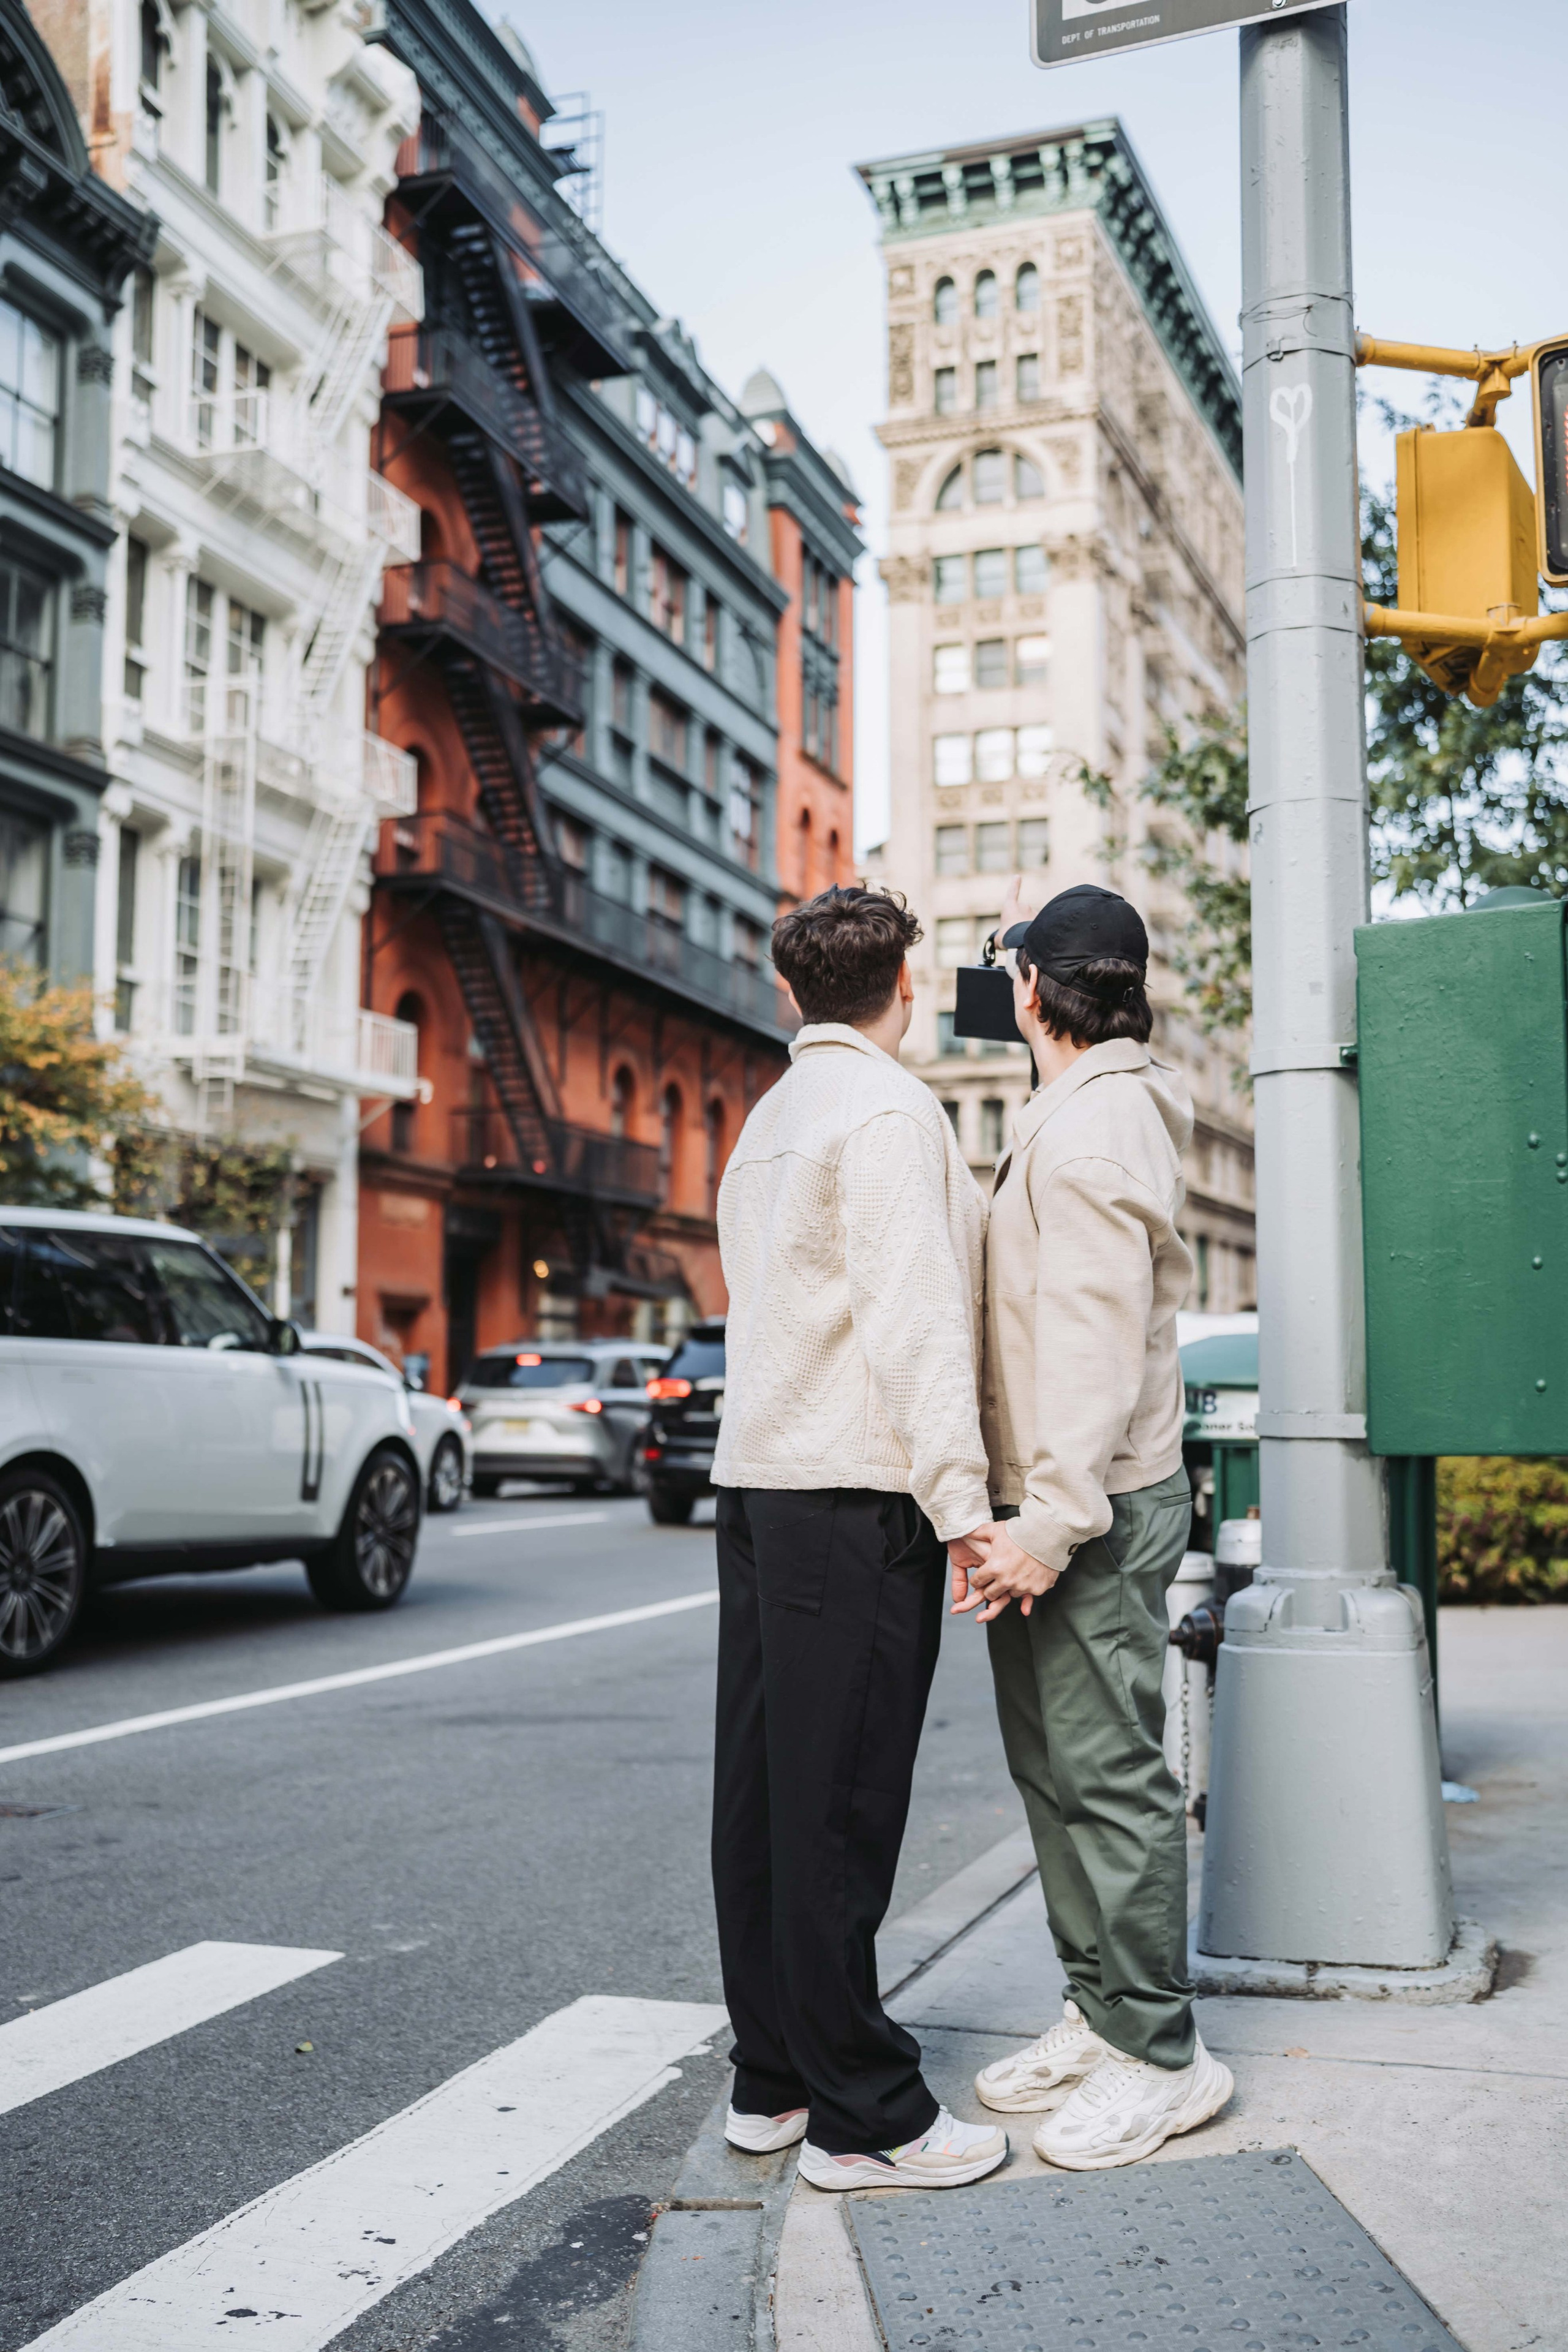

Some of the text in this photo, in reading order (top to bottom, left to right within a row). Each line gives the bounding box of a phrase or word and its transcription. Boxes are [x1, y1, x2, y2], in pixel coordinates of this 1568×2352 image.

[1061, 15, 1160, 45] DEPT OF TRANSPORTATION
